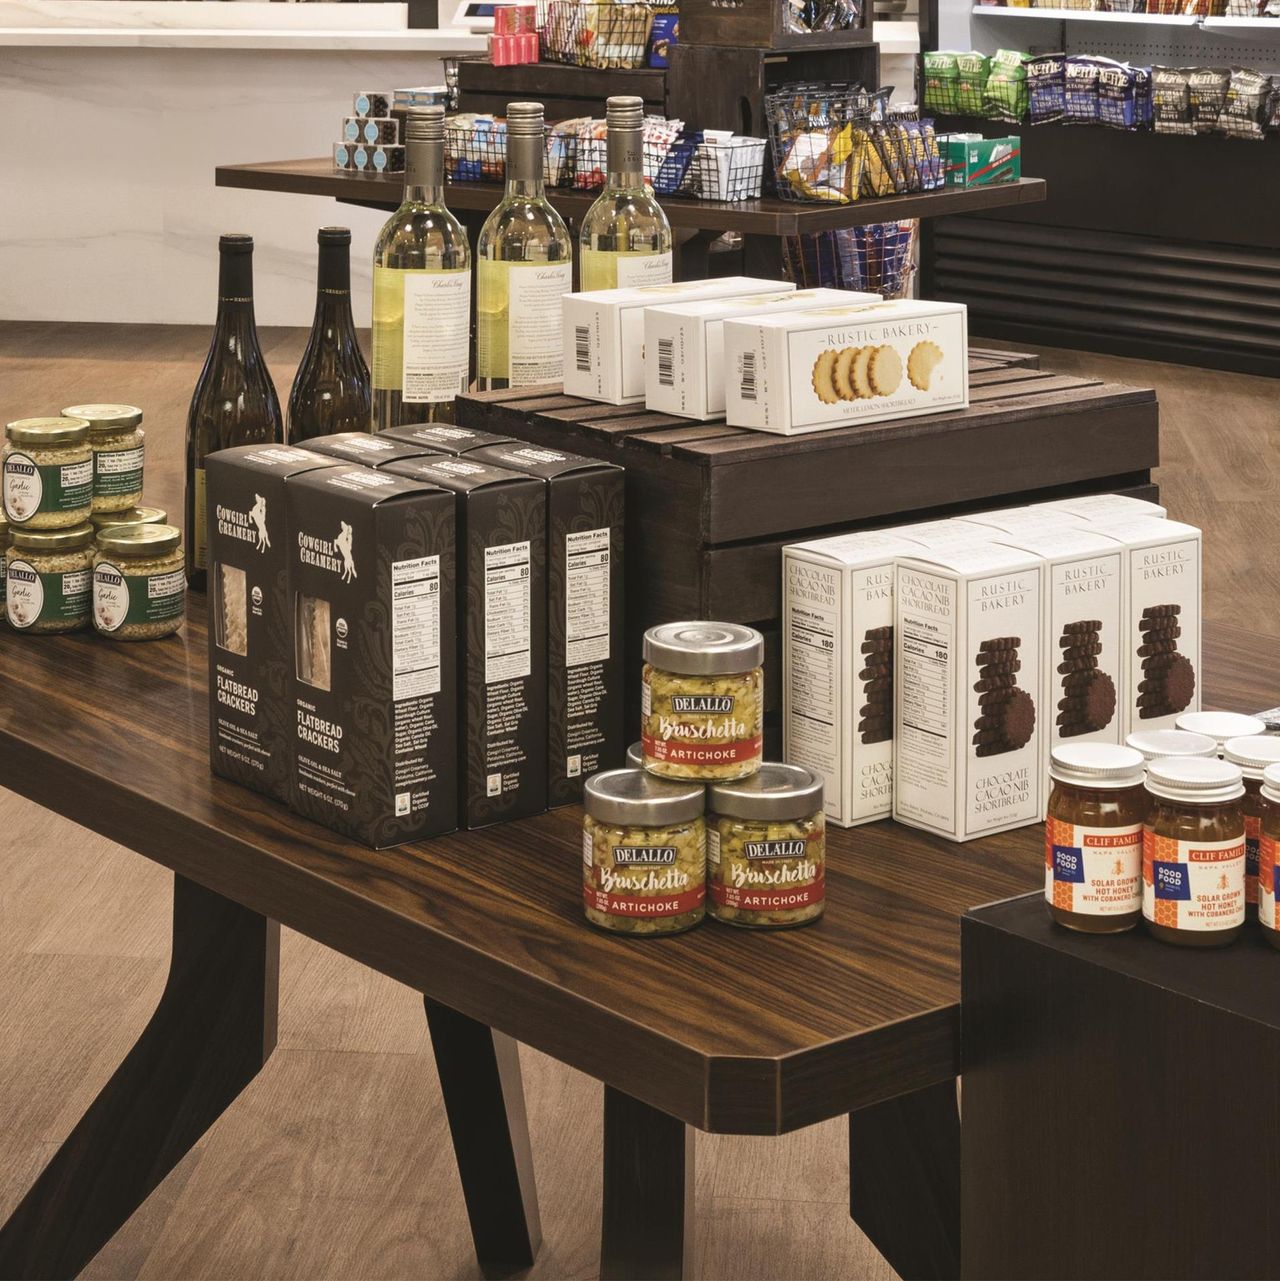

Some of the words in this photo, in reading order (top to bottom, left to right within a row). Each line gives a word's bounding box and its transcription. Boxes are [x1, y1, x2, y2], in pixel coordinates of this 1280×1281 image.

[827, 330, 879, 345] RUSTIC
[883, 323, 931, 337] BAKERY
[217, 504, 249, 527] COWGIRL
[219, 520, 257, 543] CREAMERY
[298, 531, 333, 555] COWGIRL
[300, 547, 342, 573] CREAMERY
[486, 548, 511, 556] Nutrition
[1143, 550, 1184, 566] RUSTIC
[394, 563, 420, 571] Nutrition
[487, 574, 505, 582] Calories
[521, 568, 529, 576] 80
[1065, 565, 1105, 580] RUSTIC
[1144, 564, 1184, 580] BAKERY
[429, 582, 438, 591] 80
[902, 573, 948, 594] CHOCOLATE
[981, 580, 1024, 596] RUSTIC
[1065, 579, 1106, 595] BAKERY
[902, 586, 933, 601] CACAO
[934, 593, 949, 606] NIB
[981, 595, 1024, 612] BAKERY
[902, 597, 950, 616] SHORTBREAD
[792, 633, 811, 642] Calories
[822, 639, 833, 648] 180
[904, 643, 924, 654] Calories
[935, 650, 948, 660] 180
[217, 676, 258, 702] FLATBREAD
[218, 690, 255, 715] CRACKERS
[674, 697, 732, 711] DELALLO
[297, 710, 342, 739] FLATBREAD
[659, 717, 746, 739] Bruschetta
[298, 725, 339, 753] CRACKERS
[670, 750, 736, 760] ARTICHOKE
[976, 768, 1028, 789] CHOCOLATE
[975, 784, 1011, 802] CACAO
[1013, 780, 1028, 791] NIB
[975, 792, 1029, 813] SHORTBREAD
[616, 849, 674, 863] DELALLO
[748, 842, 804, 857] DELALLO
[1056, 851, 1077, 863] GOOD
[1192, 852, 1216, 860] CLIF
[1056, 858, 1076, 869] FOOD
[601, 868, 689, 891] Bruschetta
[732, 861, 816, 887] Bruschetta
[1159, 867, 1181, 878] GOOD
[1159, 874, 1181, 885] FOOD
[1117, 877, 1137, 886] GROWN
[744, 893, 809, 905] ARTICHOKE
[1222, 892, 1240, 901] GROWN
[612, 901, 679, 912] ARTICHOKE
[1218, 901, 1236, 909] HONEY
